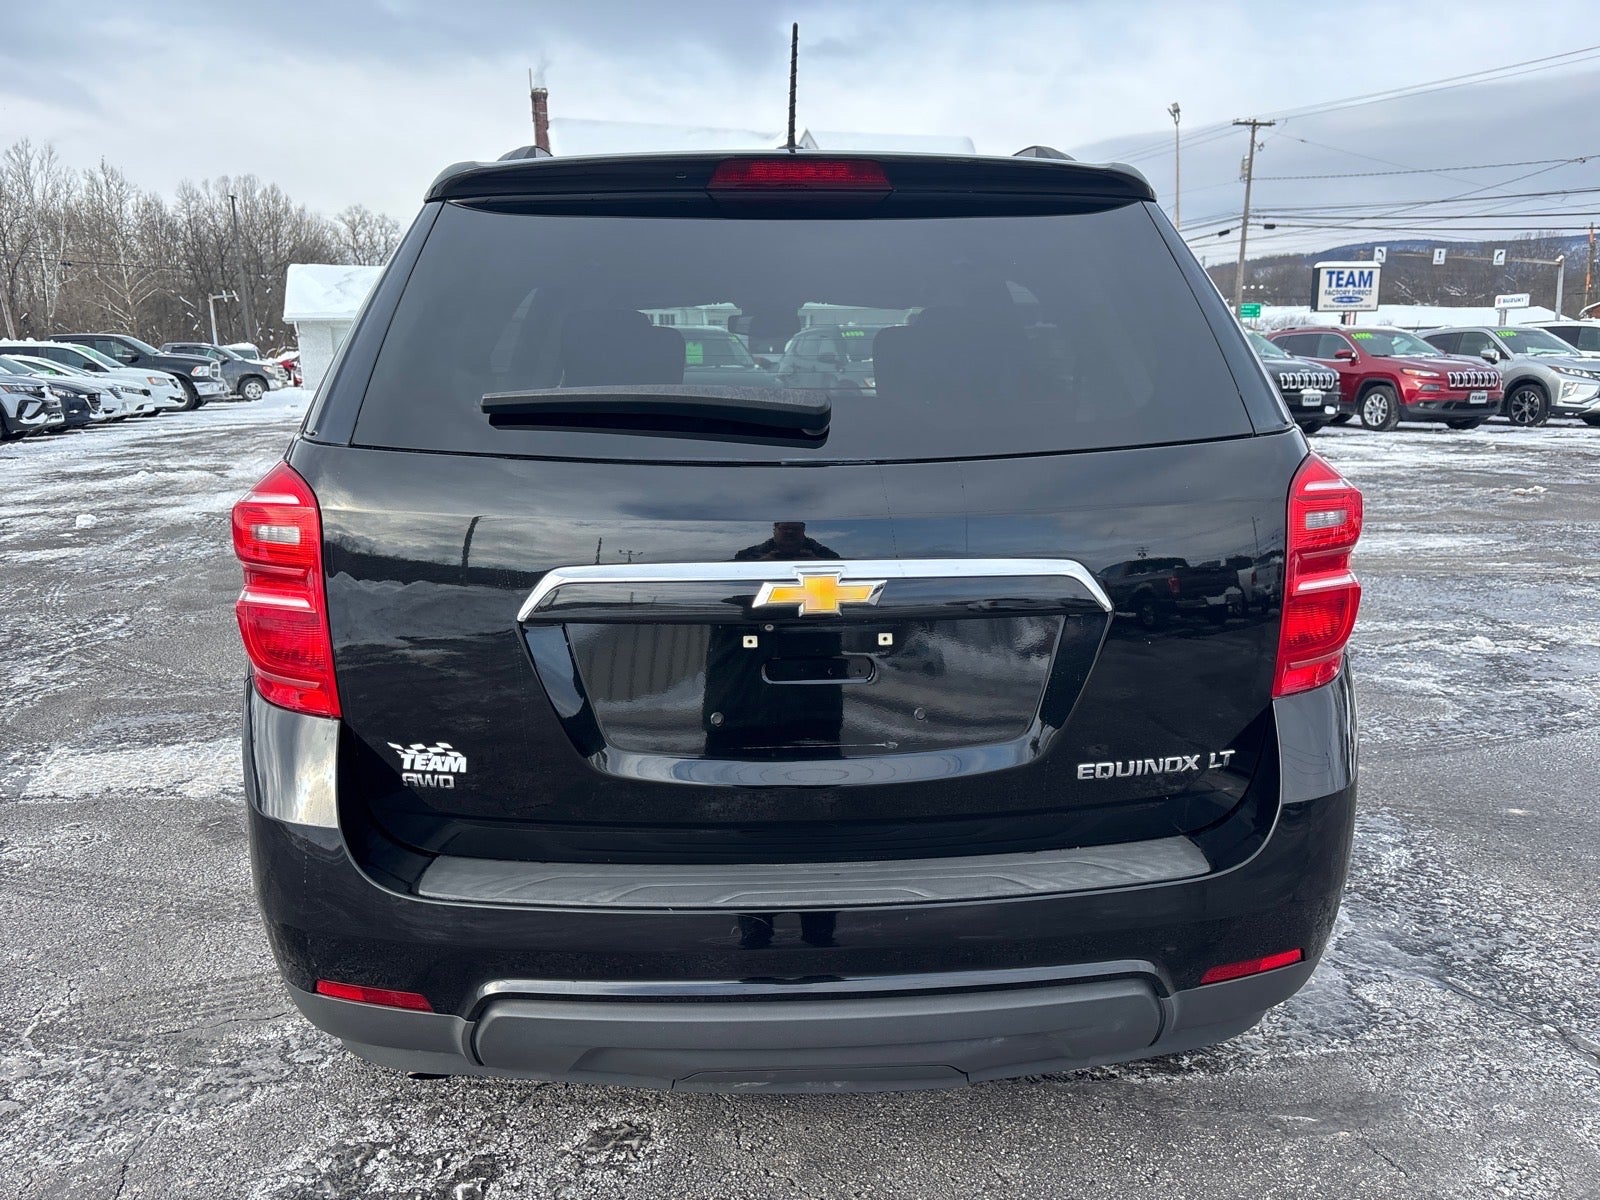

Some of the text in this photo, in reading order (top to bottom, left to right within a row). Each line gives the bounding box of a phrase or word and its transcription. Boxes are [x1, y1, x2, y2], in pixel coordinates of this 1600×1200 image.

[1326, 270, 1374, 288] TEAM
[400, 753, 467, 773] TEAM
[1077, 749, 1236, 780] EQUINOX LT
[401, 772, 455, 789] AWD
